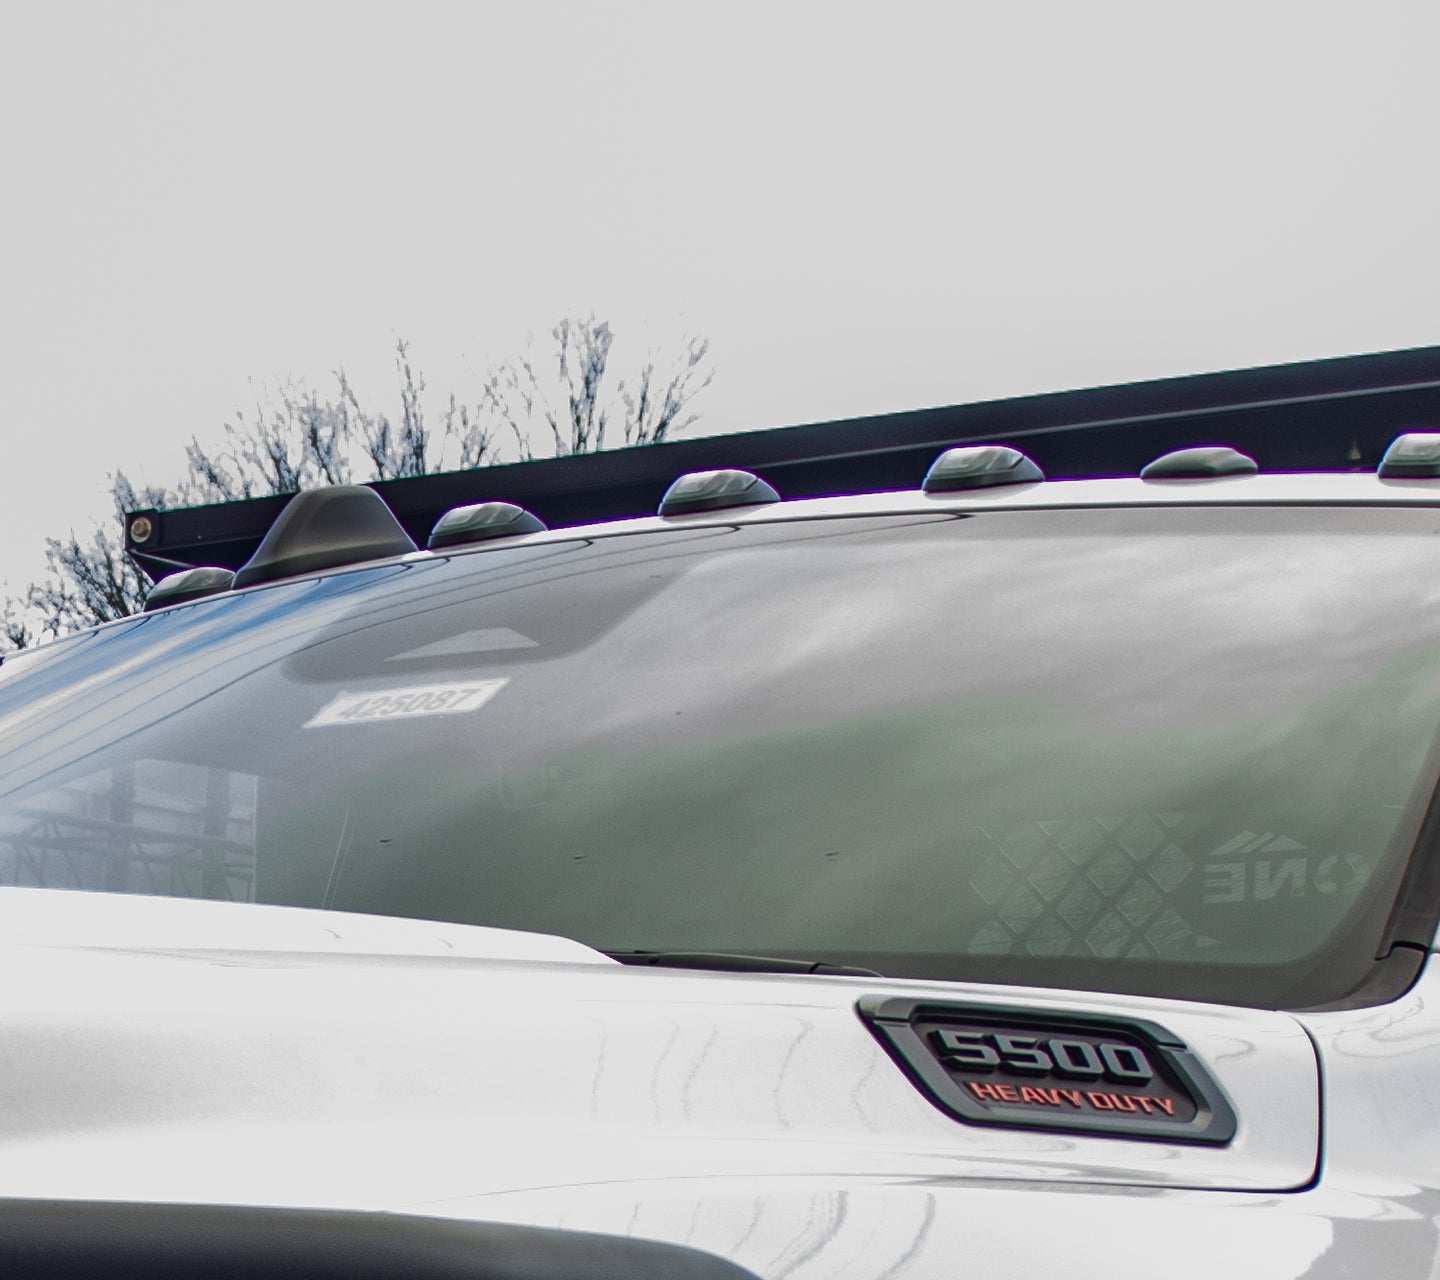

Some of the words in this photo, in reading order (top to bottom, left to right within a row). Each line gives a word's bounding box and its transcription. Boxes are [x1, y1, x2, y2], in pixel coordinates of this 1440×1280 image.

[927, 1029, 1153, 1085] 5500
[969, 1081, 1081, 1107] HEAVY
[1086, 1091, 1177, 1116] DUTY
